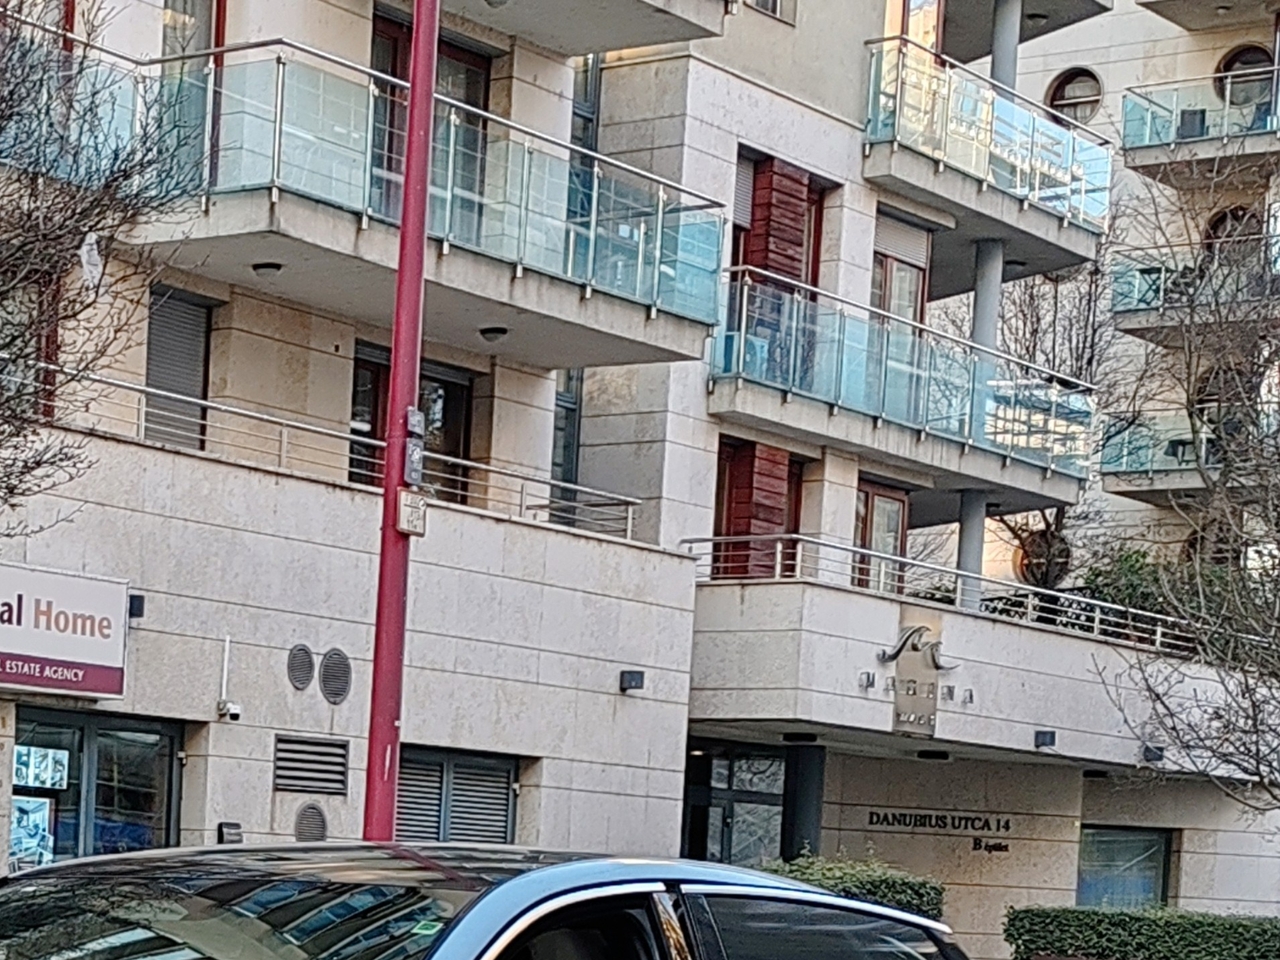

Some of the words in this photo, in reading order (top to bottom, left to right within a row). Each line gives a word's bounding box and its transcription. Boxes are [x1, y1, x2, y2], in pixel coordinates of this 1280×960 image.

[33, 598, 112, 639] Home
[5, 660, 41, 677] ESTATE
[43, 665, 85, 682] AGENCY
[869, 811, 948, 830] DANUBIUS
[951, 816, 992, 832] UTCA
[996, 818, 1011, 833] 14
[972, 837, 983, 851] B
